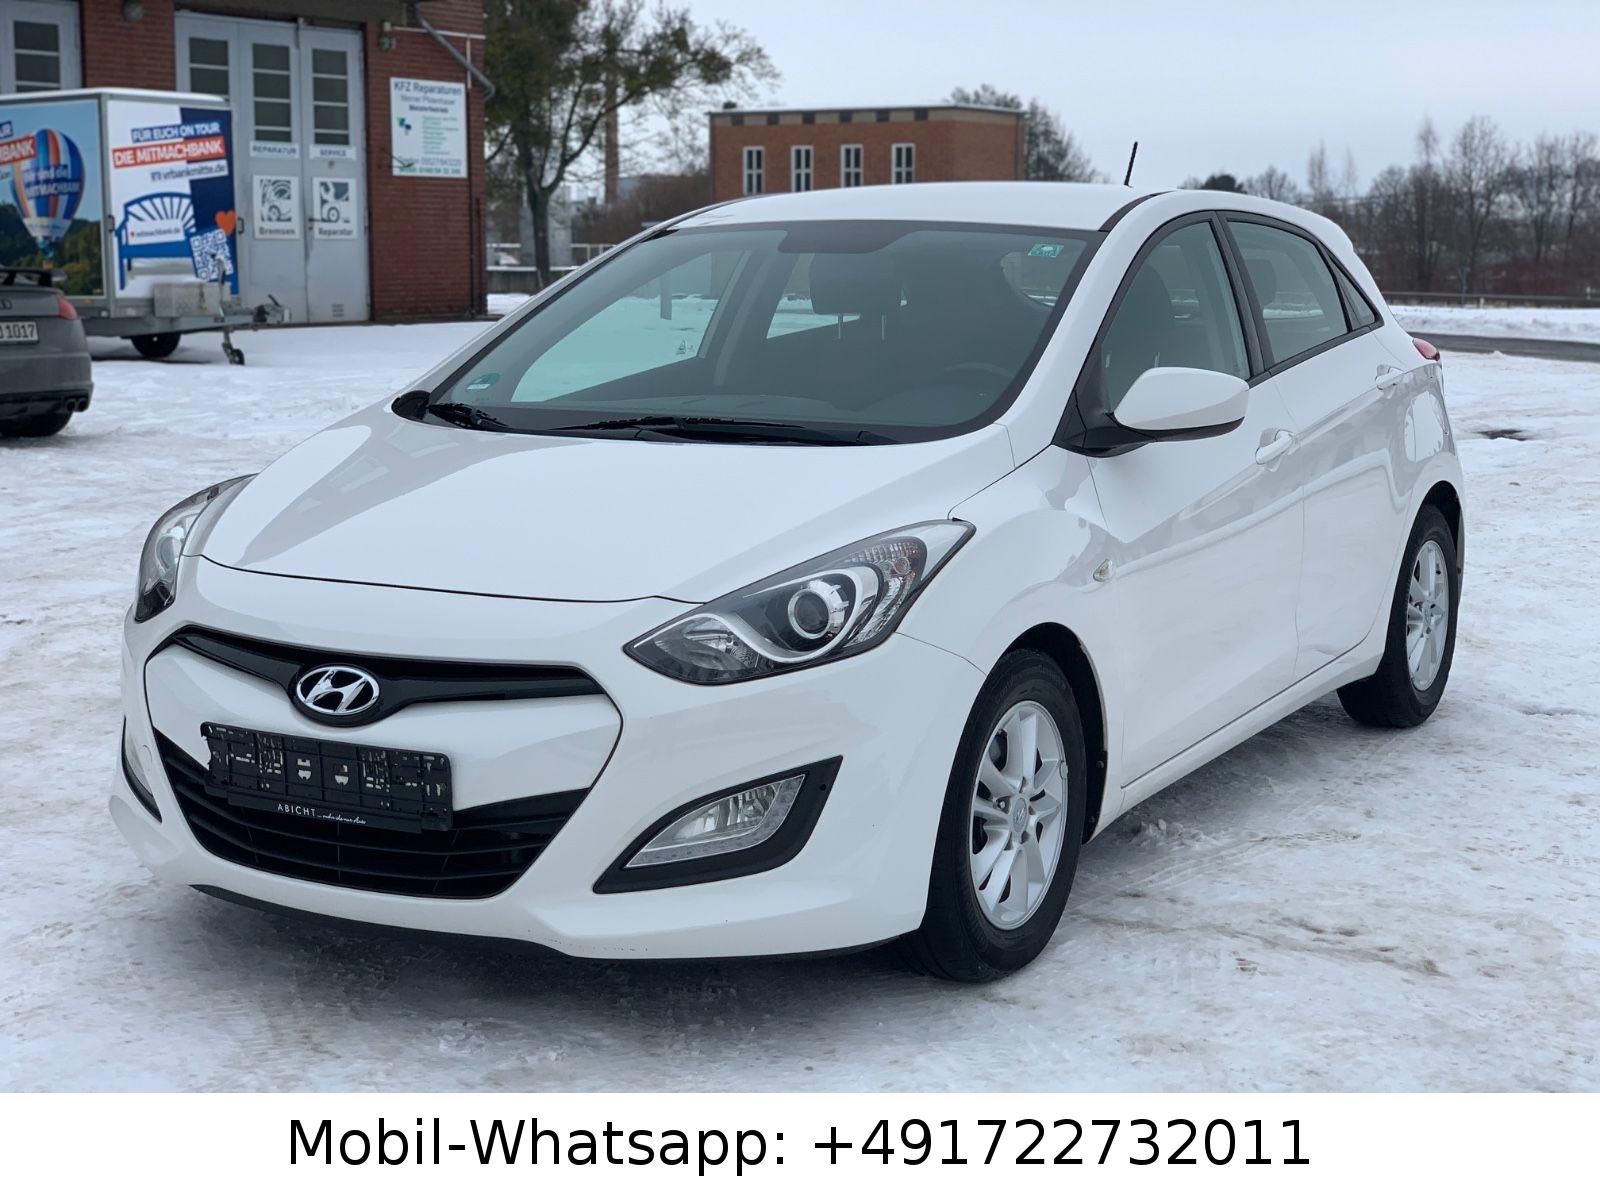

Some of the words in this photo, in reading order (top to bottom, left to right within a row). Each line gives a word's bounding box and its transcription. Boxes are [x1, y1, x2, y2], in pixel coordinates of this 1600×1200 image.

[393, 81, 411, 92] KFZ
[413, 82, 462, 95] Reparaturen
[132, 128, 152, 141] FÜR
[153, 126, 178, 139] EUCH
[180, 124, 194, 136] ON
[195, 122, 220, 135] TOUR
[0, 138, 35, 160] BANK
[114, 149, 135, 166] DIE
[136, 139, 224, 163] MITMACHBANK
[252, 145, 297, 155] REPARATUR
[259, 226, 296, 235] Bremsen
[318, 227, 353, 236] Reparatur
[278, 803, 315, 817] ABICHT
